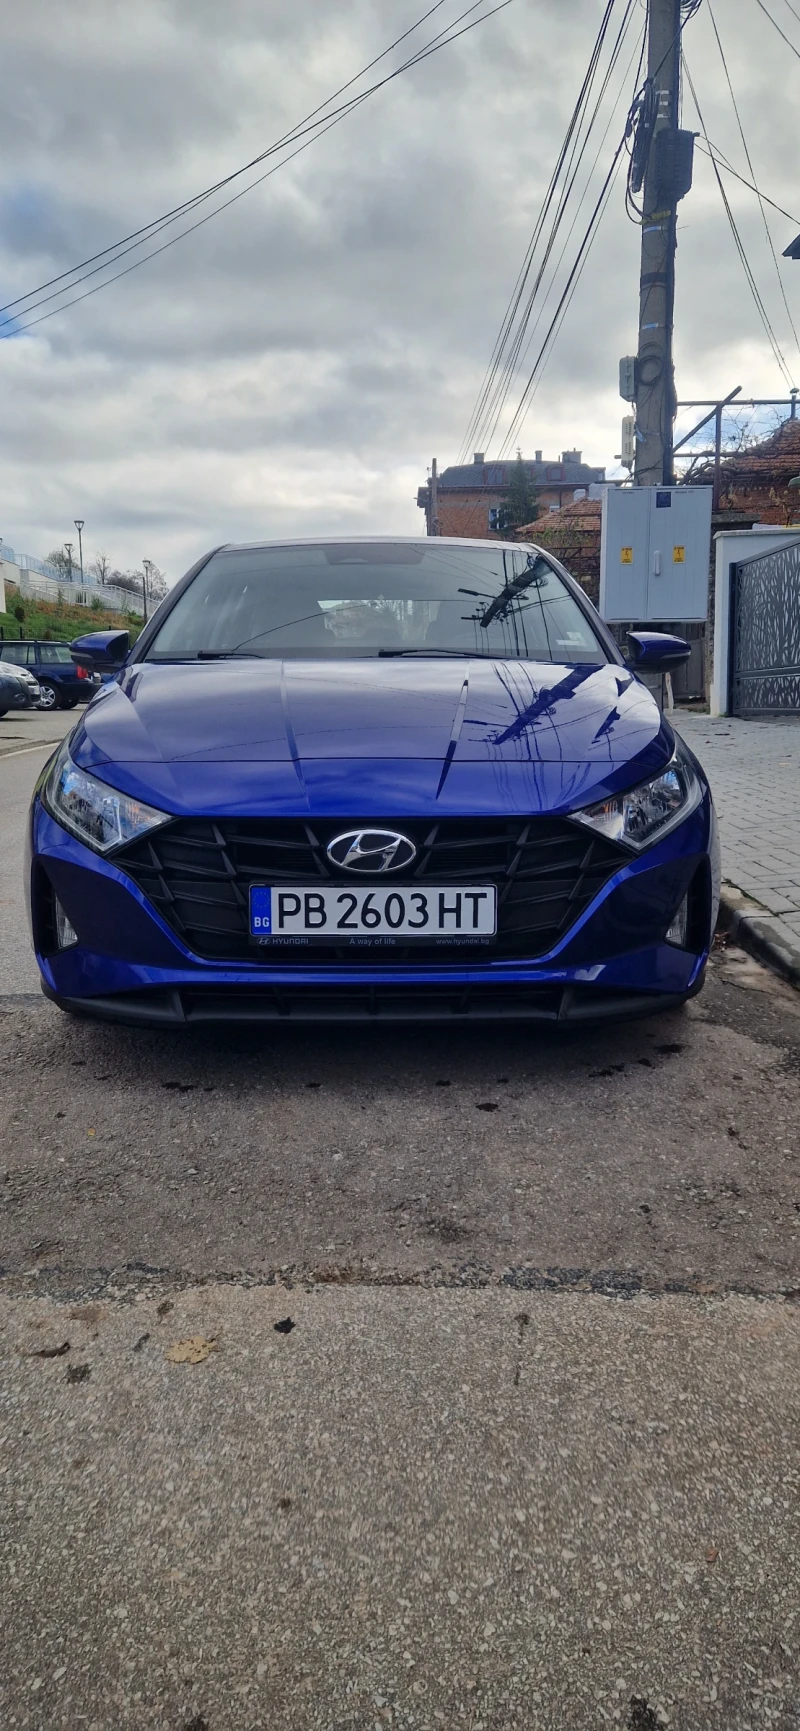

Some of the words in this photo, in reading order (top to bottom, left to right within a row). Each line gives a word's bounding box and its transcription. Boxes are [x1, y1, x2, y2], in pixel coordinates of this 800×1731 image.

[278, 893, 327, 928] PB
[337, 893, 429, 928] 2603
[439, 893, 487, 928] HT
[254, 918, 269, 927] BG
[436, 938, 490, 946] www.hyundai.bg
